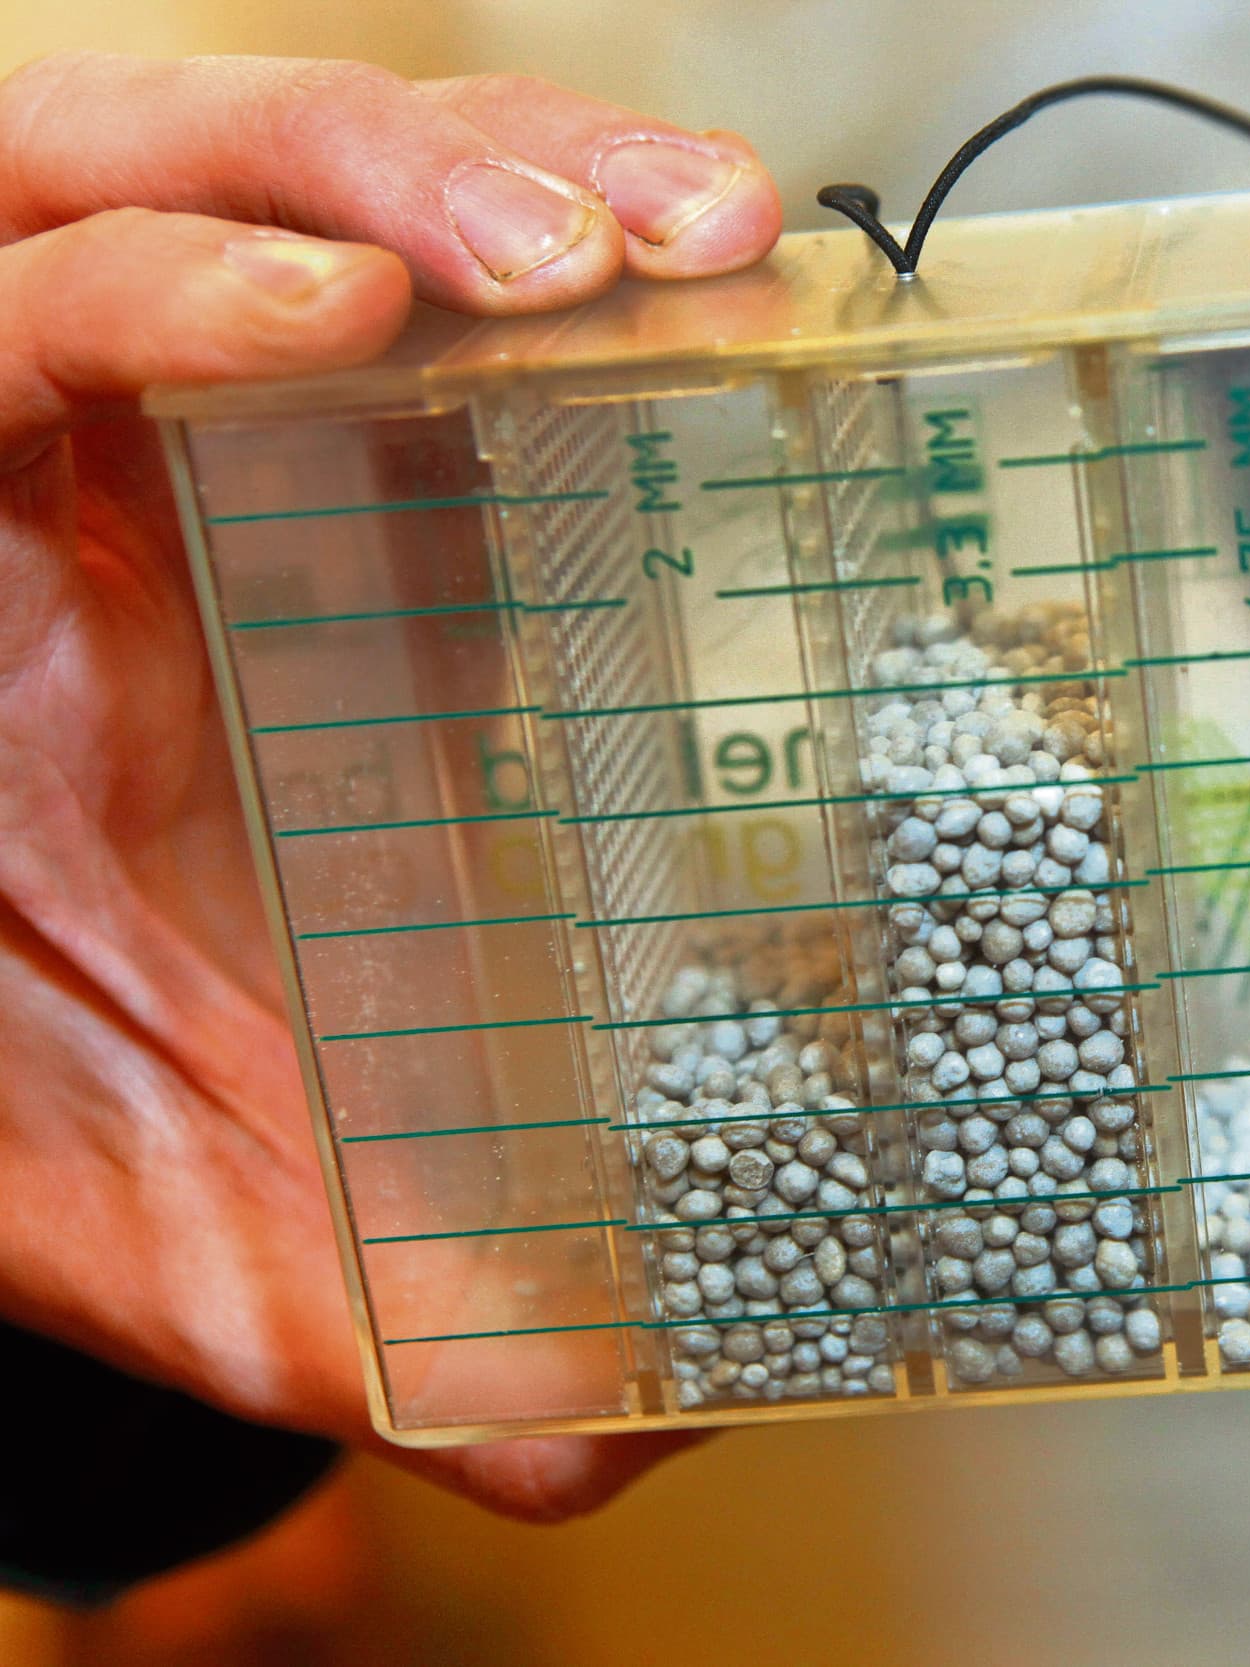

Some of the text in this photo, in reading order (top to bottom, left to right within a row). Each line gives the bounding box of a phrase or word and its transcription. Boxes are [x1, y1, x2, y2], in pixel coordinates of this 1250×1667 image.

[626, 431, 694, 579] 2 MM
[924, 408, 982, 493] MM
